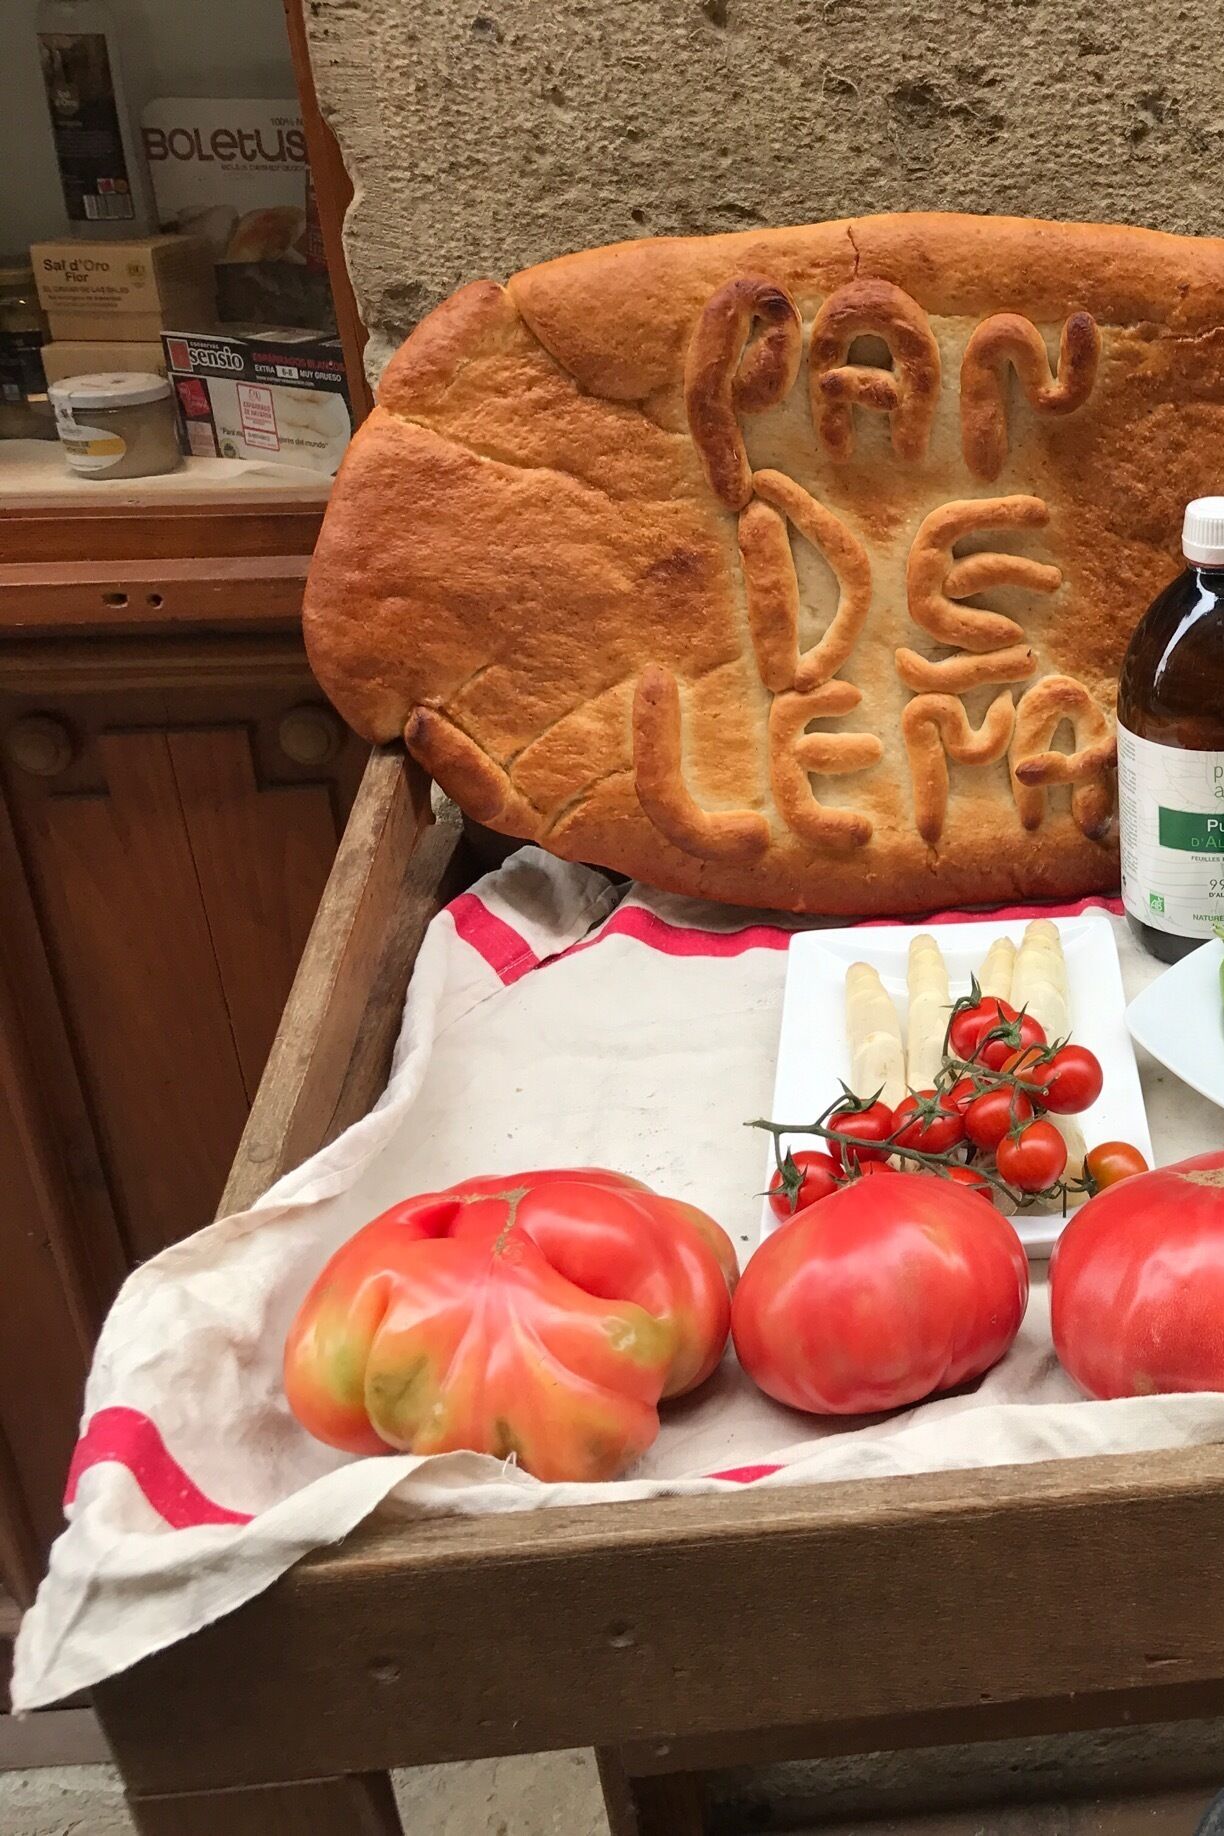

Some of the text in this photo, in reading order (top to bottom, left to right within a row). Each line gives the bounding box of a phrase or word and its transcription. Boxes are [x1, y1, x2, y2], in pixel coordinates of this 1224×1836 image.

[43, 258, 110, 272] Sal d'Oro
[254, 365, 275, 374] EXTRA
[300, 370, 314, 379] MUY
[314, 371, 342, 382] GRUESO
[684, 273, 1103, 512] PAN
[738, 468, 1063, 695] DE
